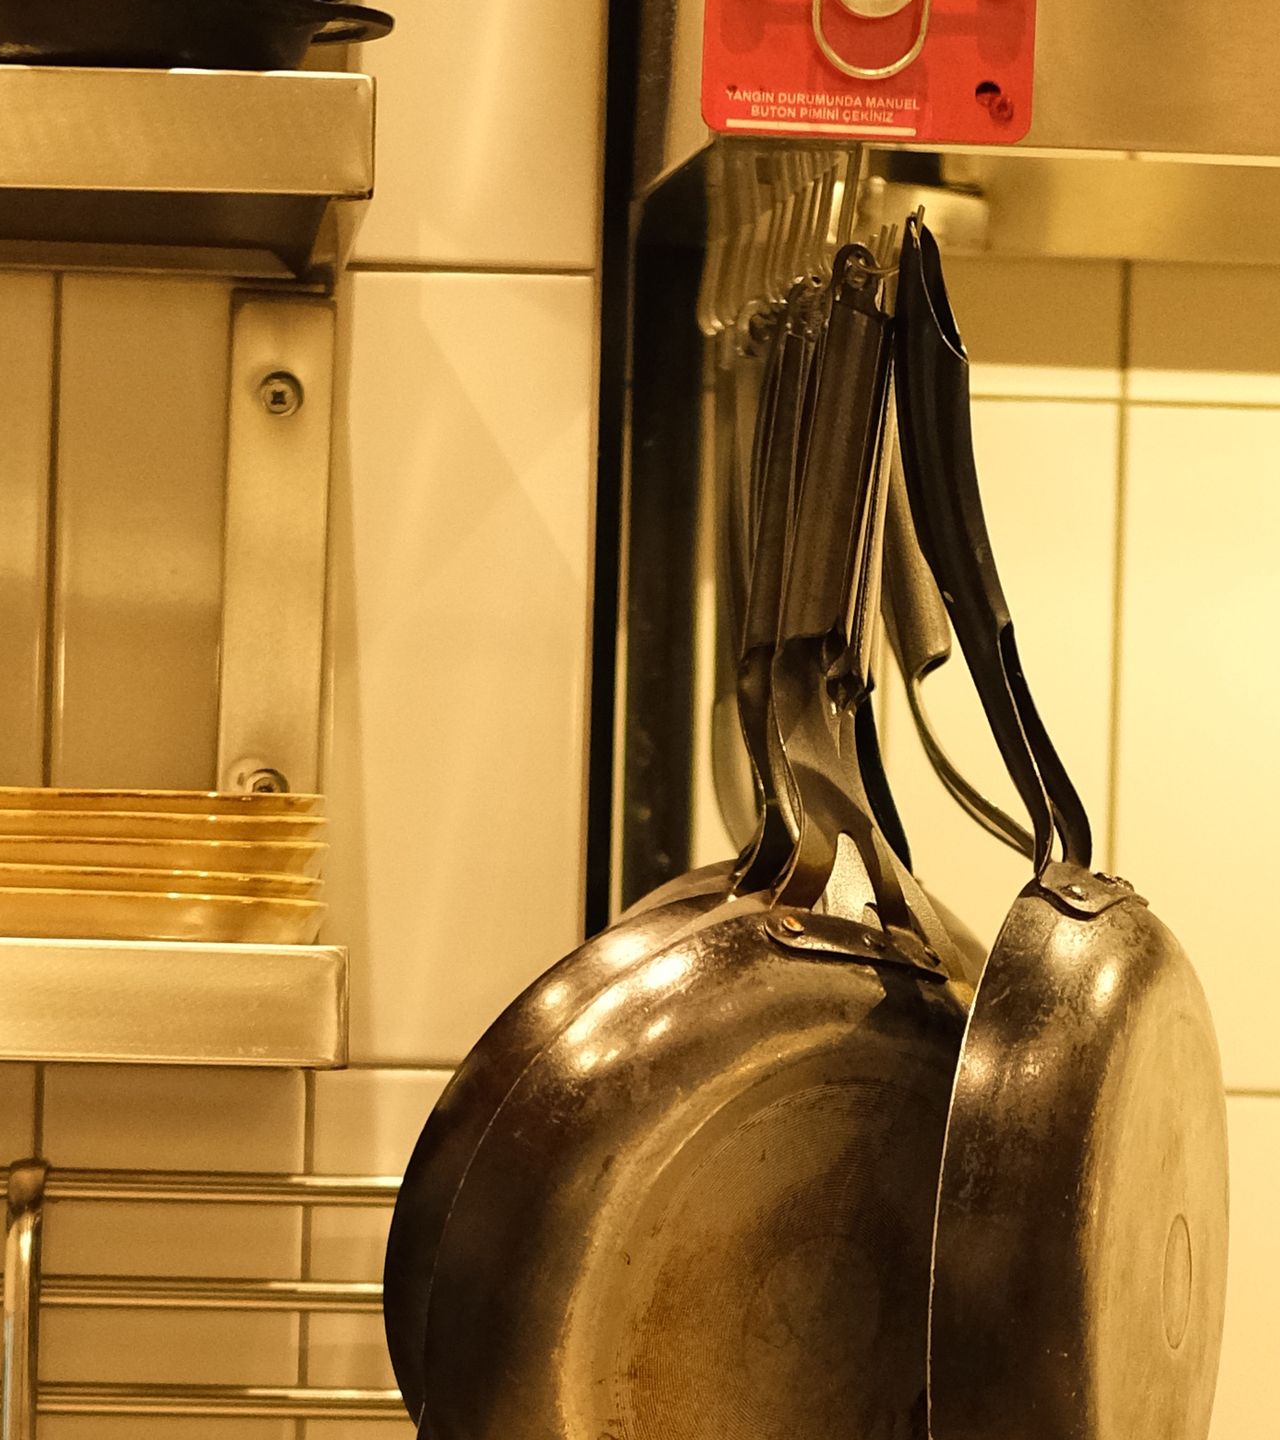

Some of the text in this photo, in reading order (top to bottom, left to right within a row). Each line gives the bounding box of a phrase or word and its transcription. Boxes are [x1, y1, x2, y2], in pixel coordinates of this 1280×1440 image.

[726, 89, 920, 110] YANGIN DURUMUNDA MANUEL
[751, 105, 894, 123] BUTON PİMİNİ ÇEKİNİZ
